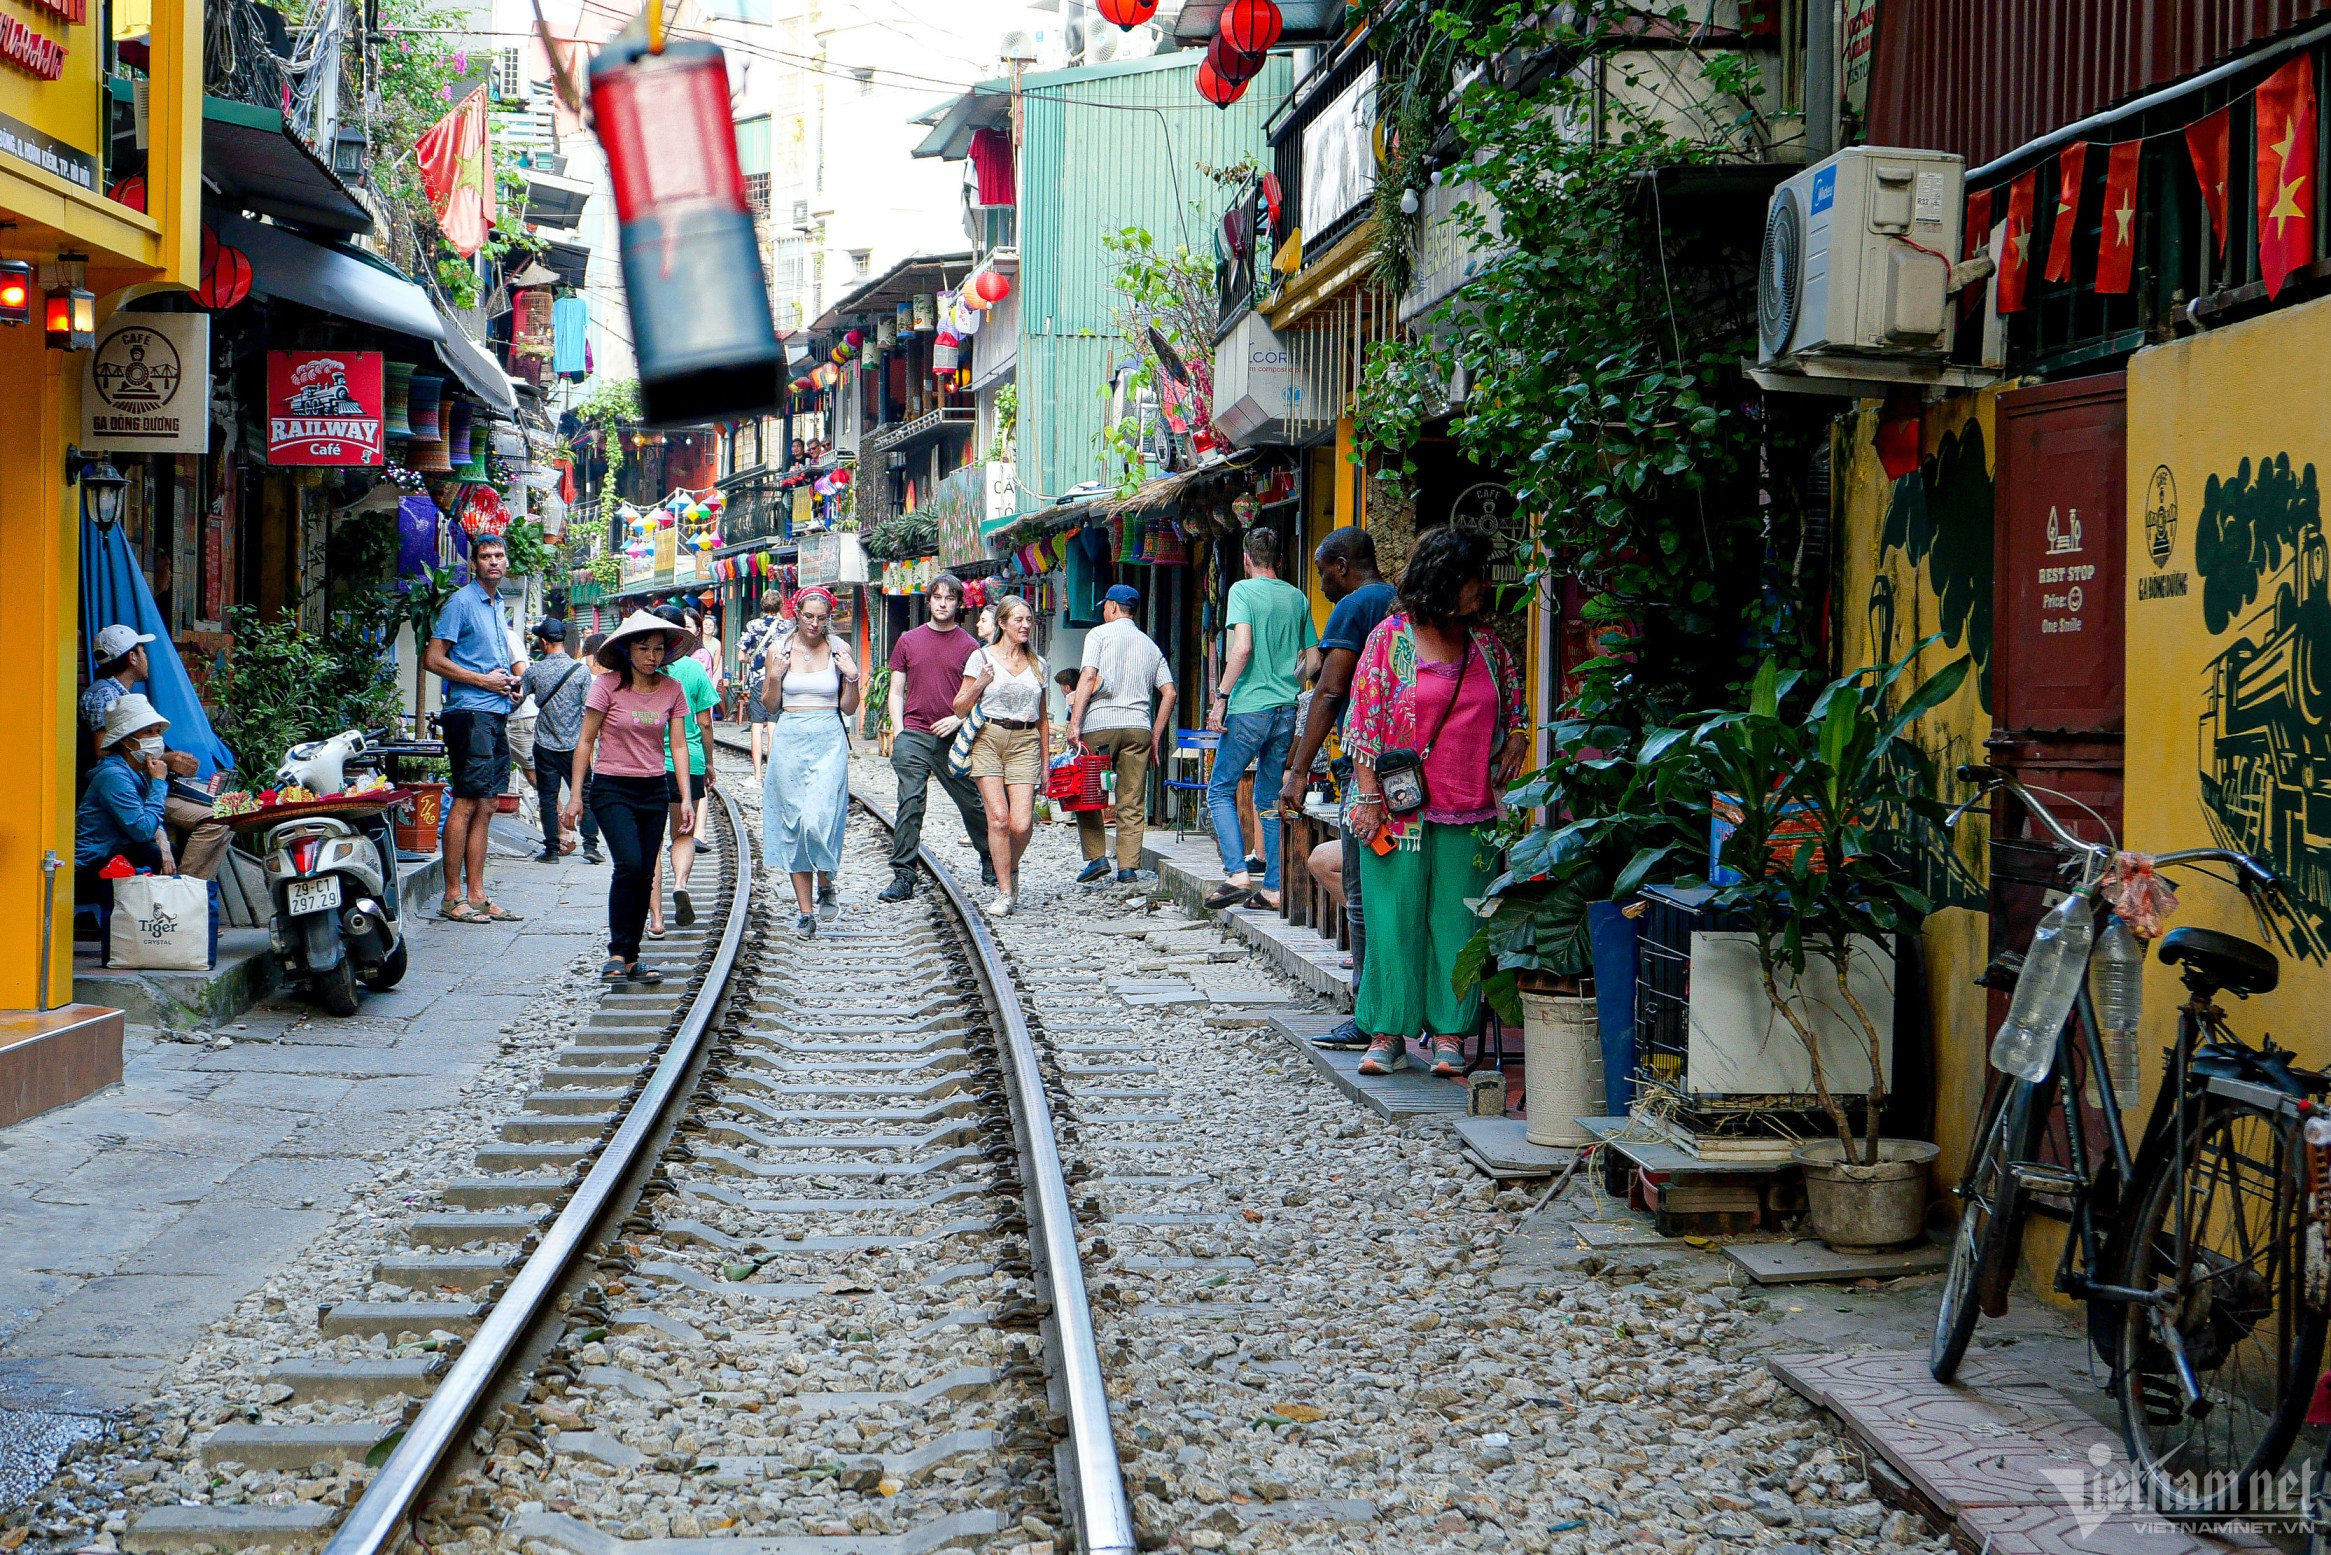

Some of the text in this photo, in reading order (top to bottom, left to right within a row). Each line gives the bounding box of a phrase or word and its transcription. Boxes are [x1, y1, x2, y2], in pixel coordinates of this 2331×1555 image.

[121, 333, 152, 346] CAFÉ
[93, 413, 179, 431] GA ĐÔNG DƯƠNG
[271, 420, 378, 443] RAILWAY
[309, 443, 341, 455] Café
[2039, 564, 2095, 584] REST STOP
[2043, 593, 2067, 609] Price:
[2042, 617, 2082, 633] One Smile
[631, 710, 662, 718] BERRY
[641, 717, 654, 725] ME
[295, 879, 330, 897] 29-C1
[292, 892, 337, 913] 297.29
[138, 919, 178, 938] Tiger
